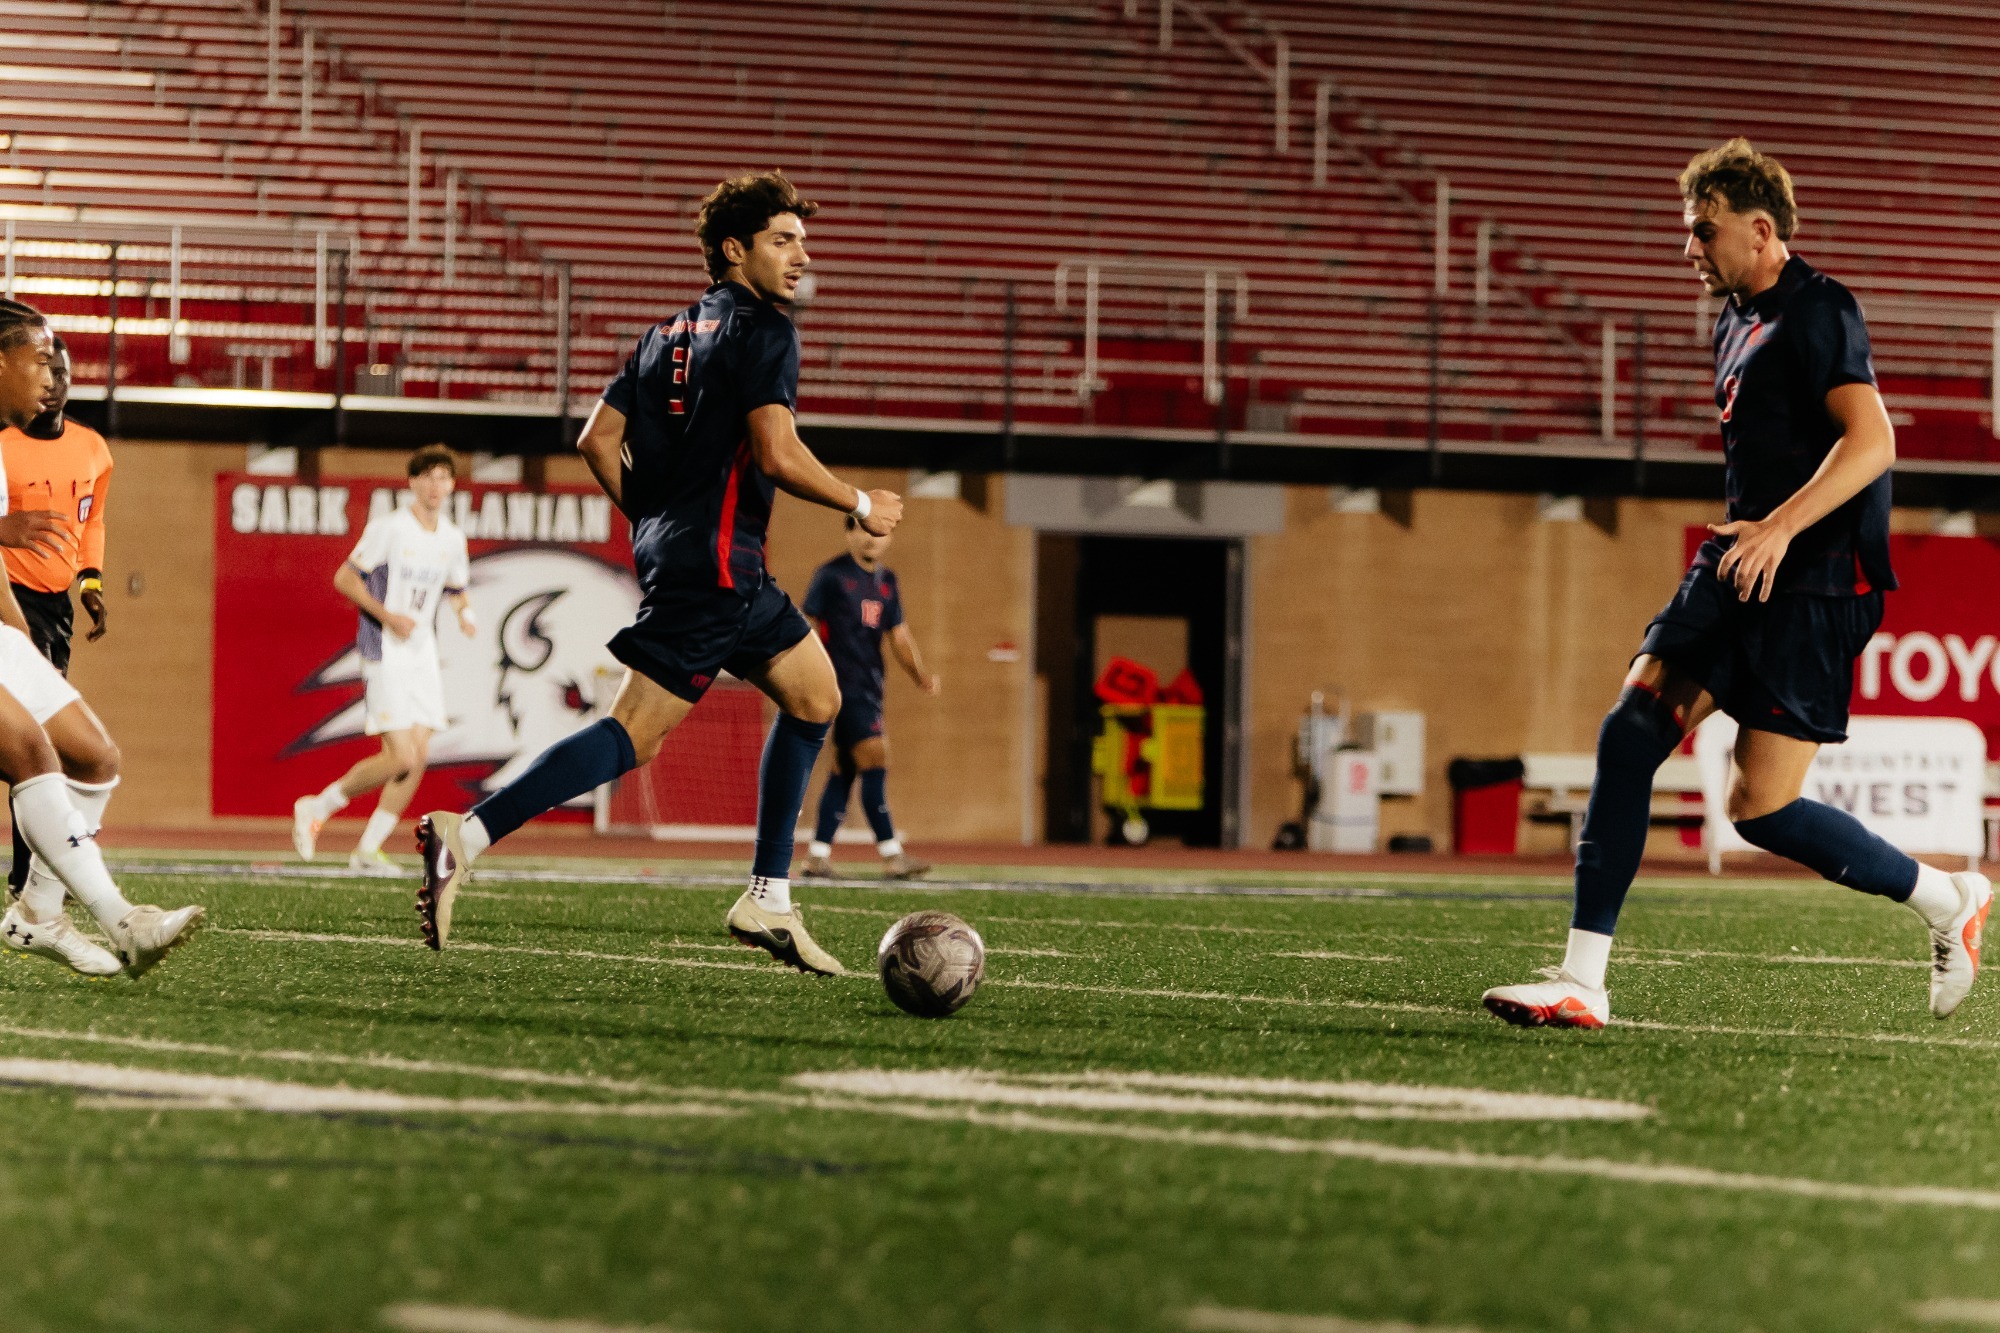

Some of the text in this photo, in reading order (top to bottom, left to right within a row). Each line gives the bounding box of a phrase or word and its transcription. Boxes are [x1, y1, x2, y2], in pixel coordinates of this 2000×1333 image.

[231, 484, 612, 542] SARK ALANIAN
[1860, 631, 2000, 702] TOY
